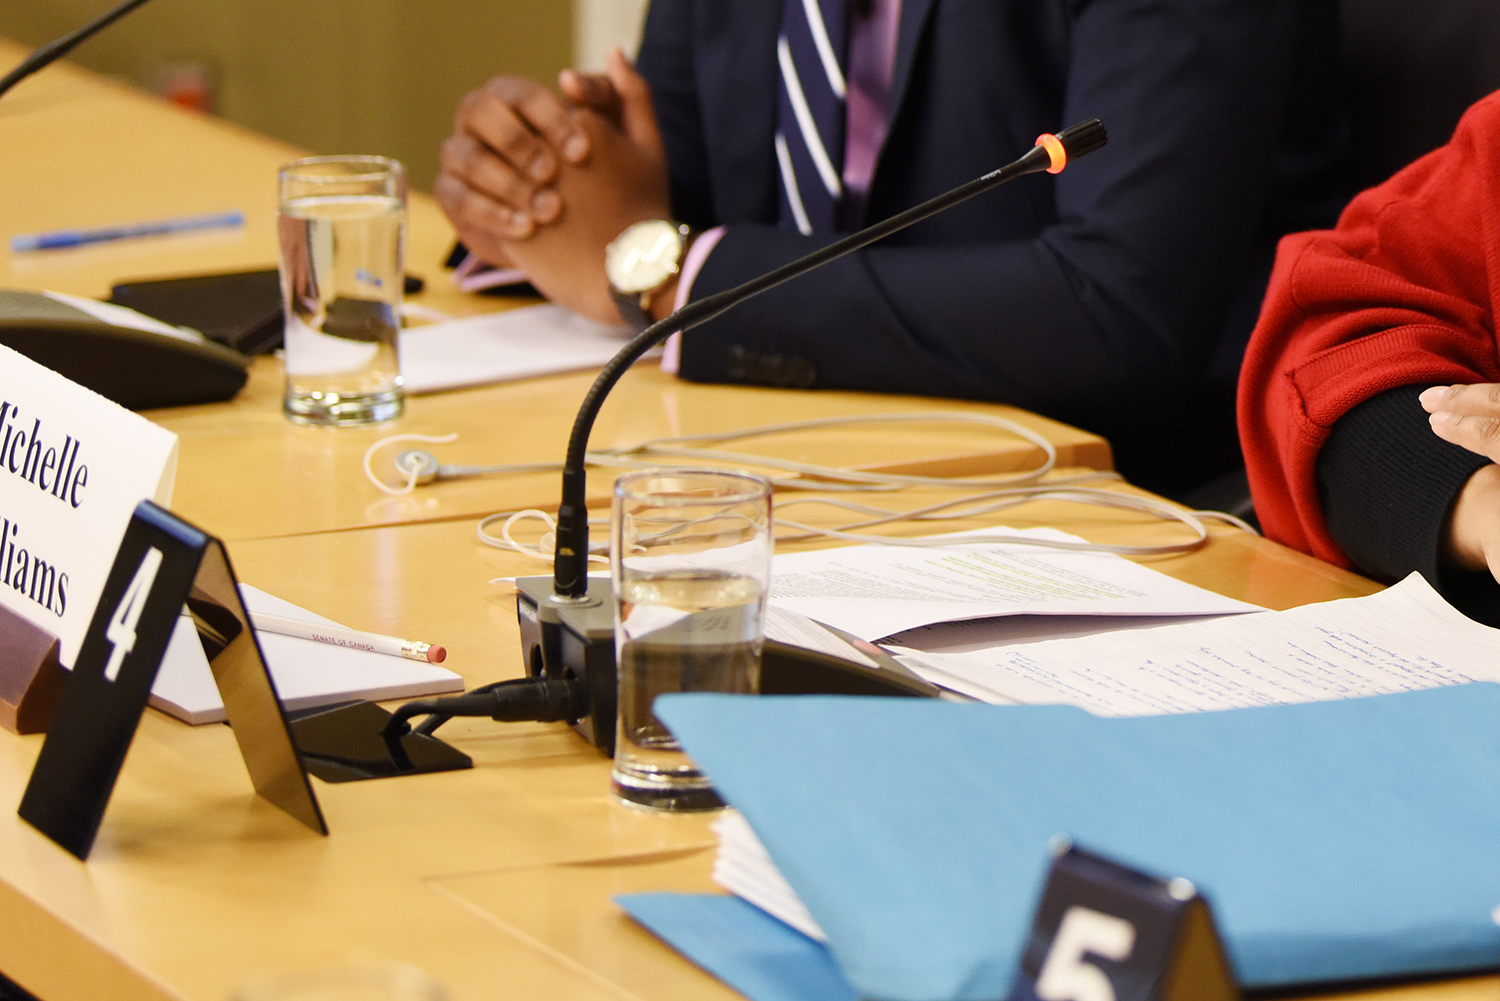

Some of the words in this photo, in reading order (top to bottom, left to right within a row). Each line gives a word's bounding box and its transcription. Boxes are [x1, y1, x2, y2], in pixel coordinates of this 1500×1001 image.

[0, 515, 69, 618] liams
[104, 546, 163, 682] 4
[311, 633, 336, 644] SENATE
[338, 639, 346, 647] OF
[349, 640, 375, 651] CANADA
[1035, 905, 1136, 1001] 5
